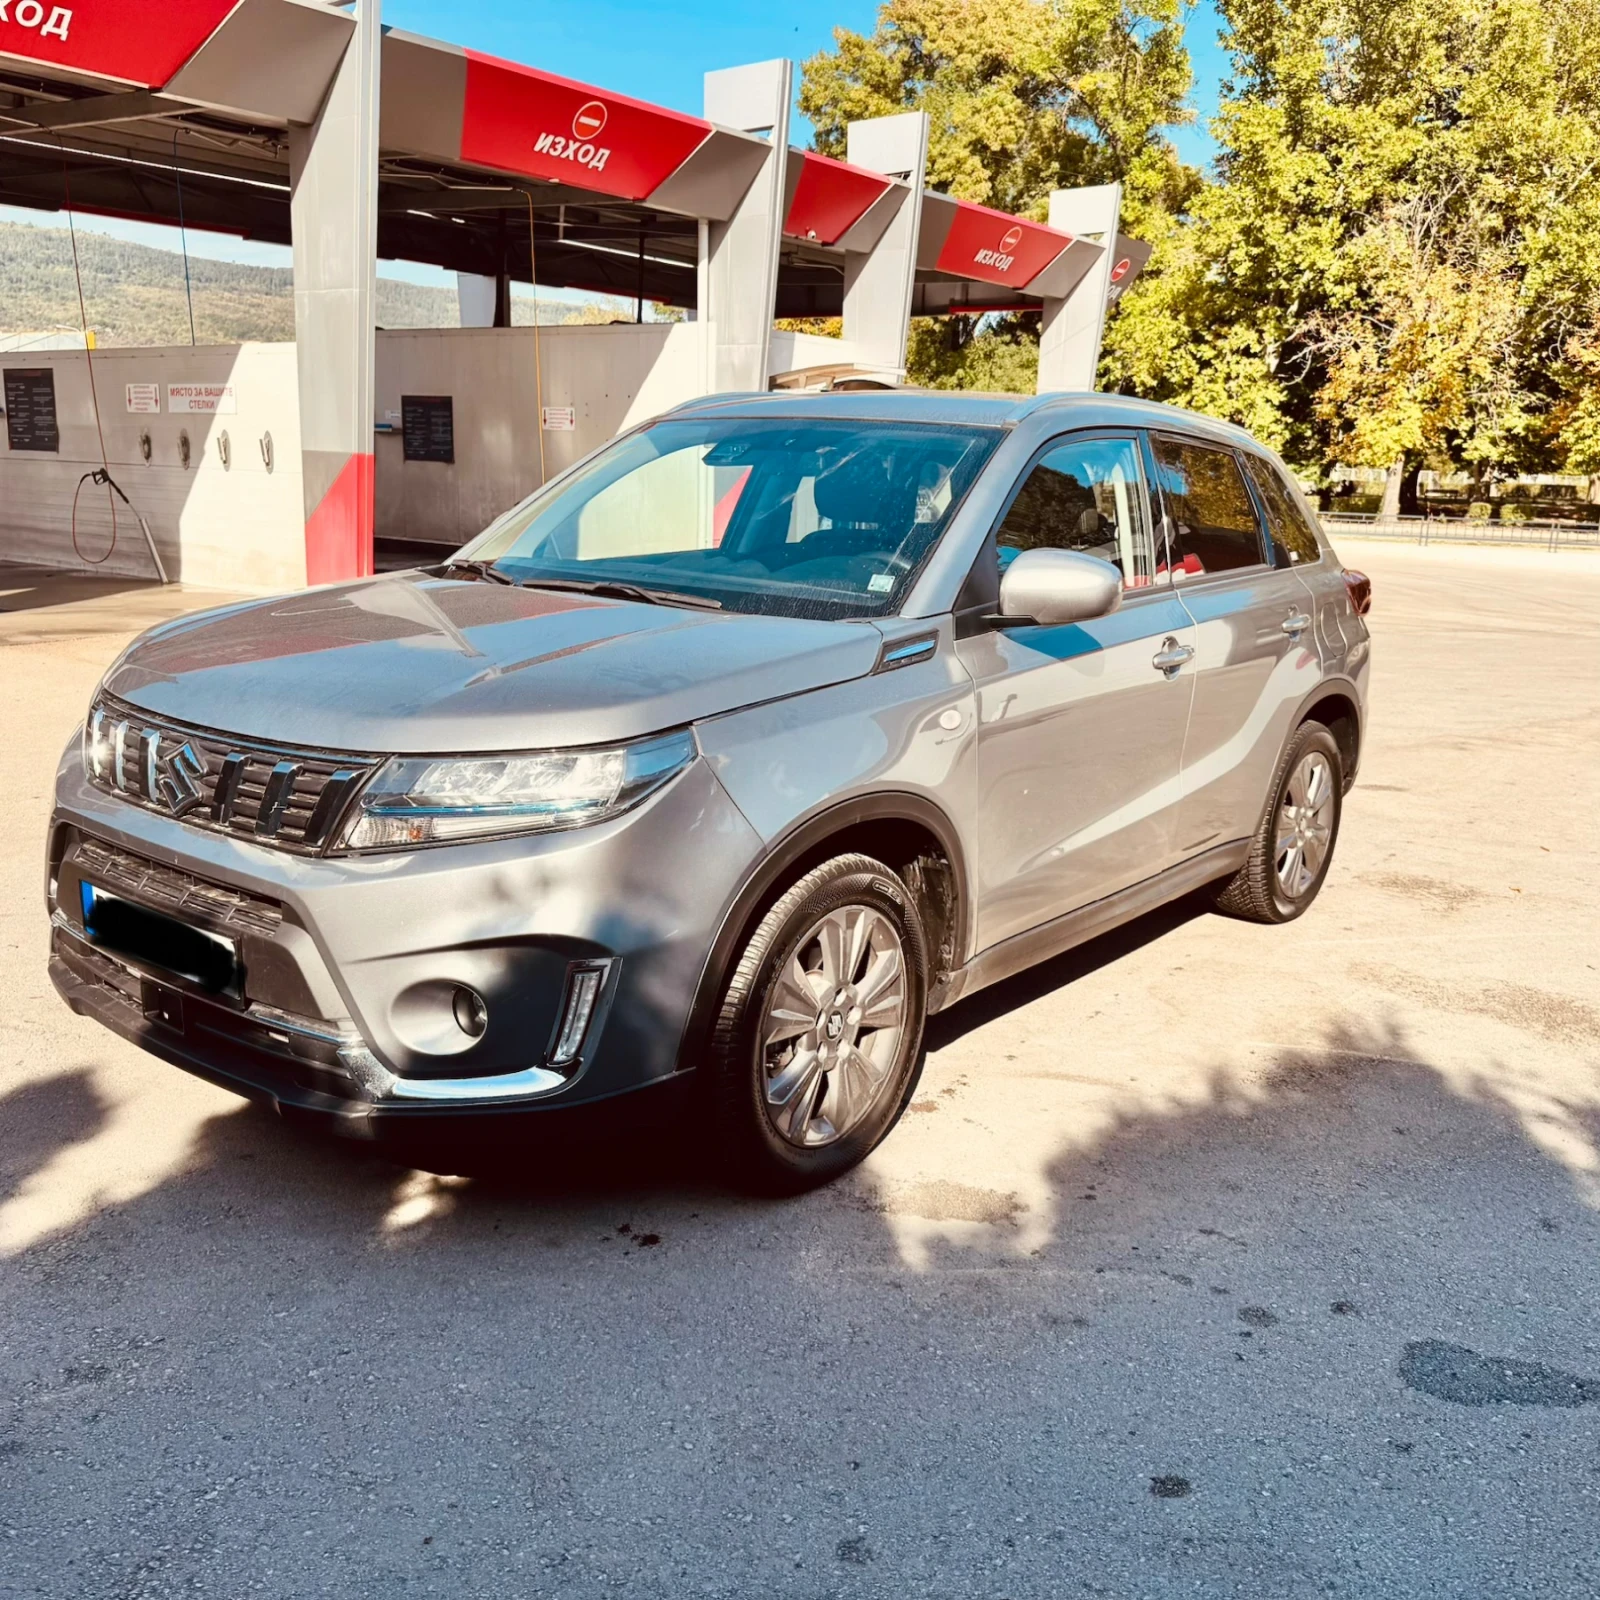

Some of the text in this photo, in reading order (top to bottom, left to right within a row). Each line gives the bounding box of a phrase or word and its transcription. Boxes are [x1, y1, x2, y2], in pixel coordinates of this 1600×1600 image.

[533, 132, 611, 172] ИЗХОД
[973, 248, 1015, 272] ИЗХОД
[170, 387, 233, 397] МЯСТО ЗА ВАШИТЕ
[188, 400, 215, 409] СТЕЛКИ
